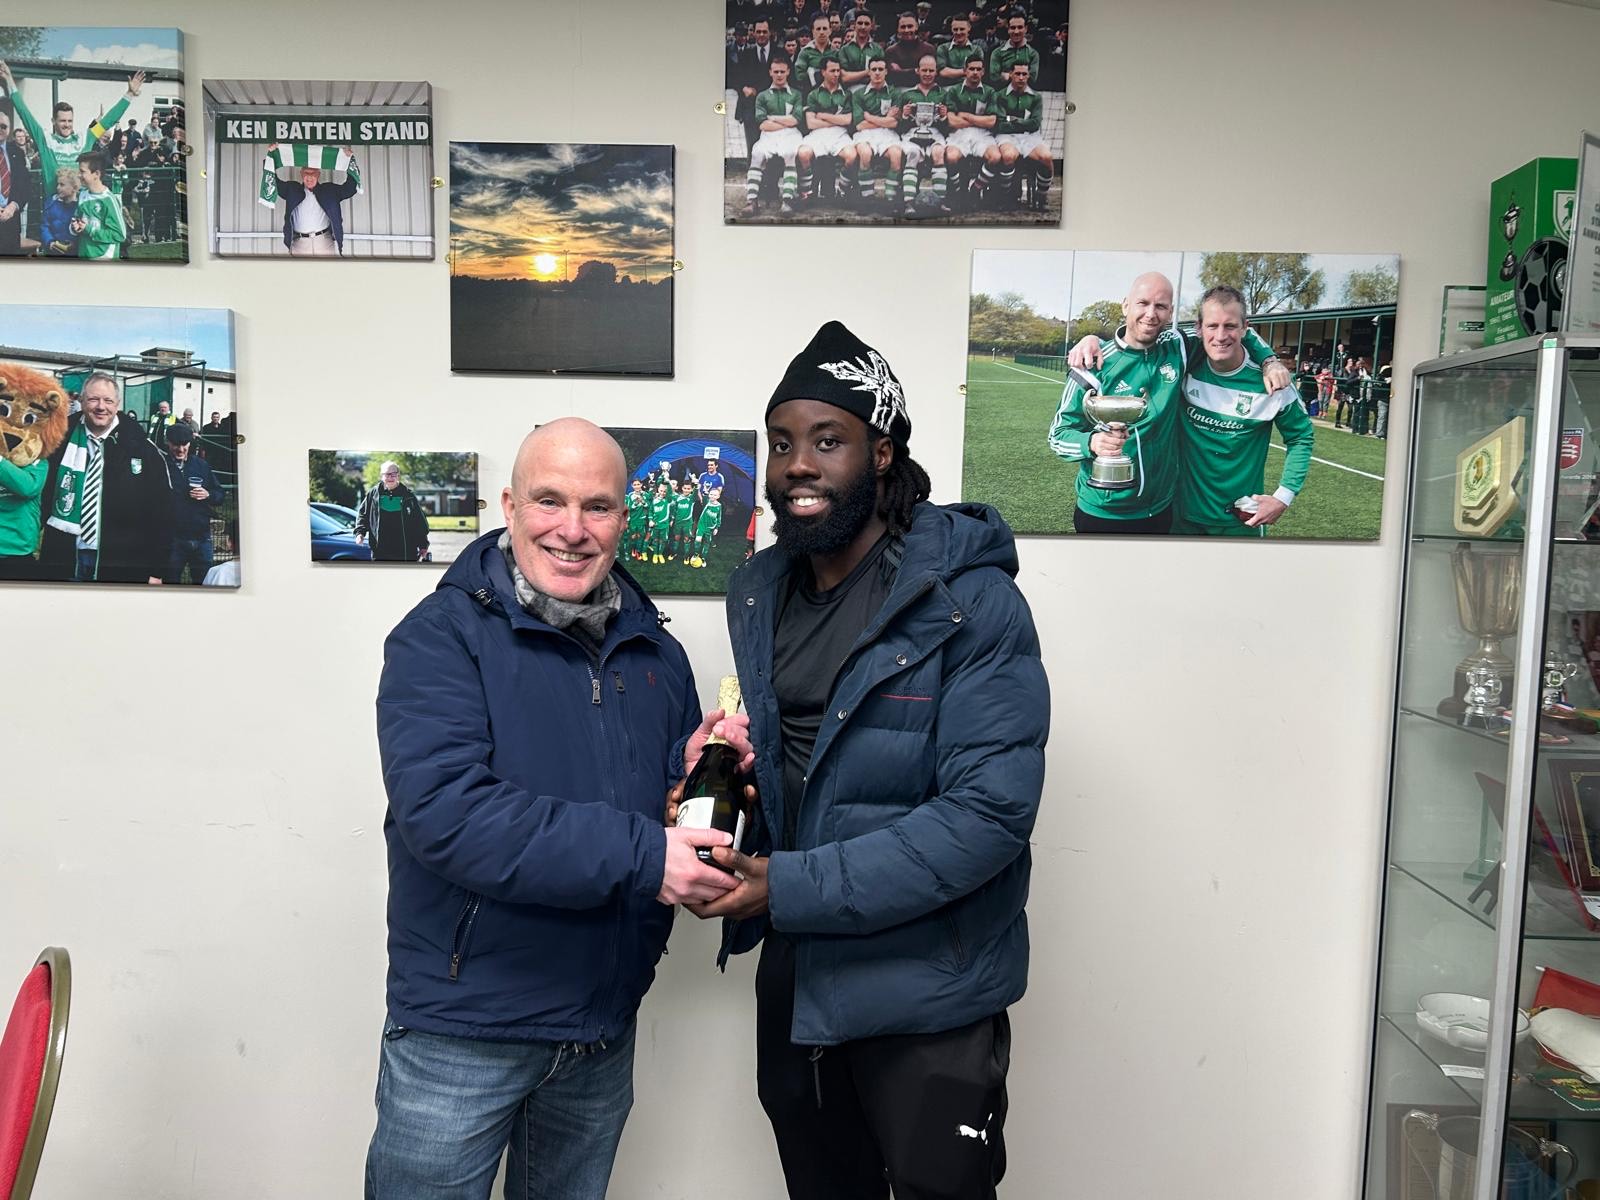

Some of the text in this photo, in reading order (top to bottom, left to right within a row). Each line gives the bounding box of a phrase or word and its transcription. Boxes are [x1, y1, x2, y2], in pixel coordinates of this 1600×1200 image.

[226, 120, 429, 141] KEN BATTEN STAND
